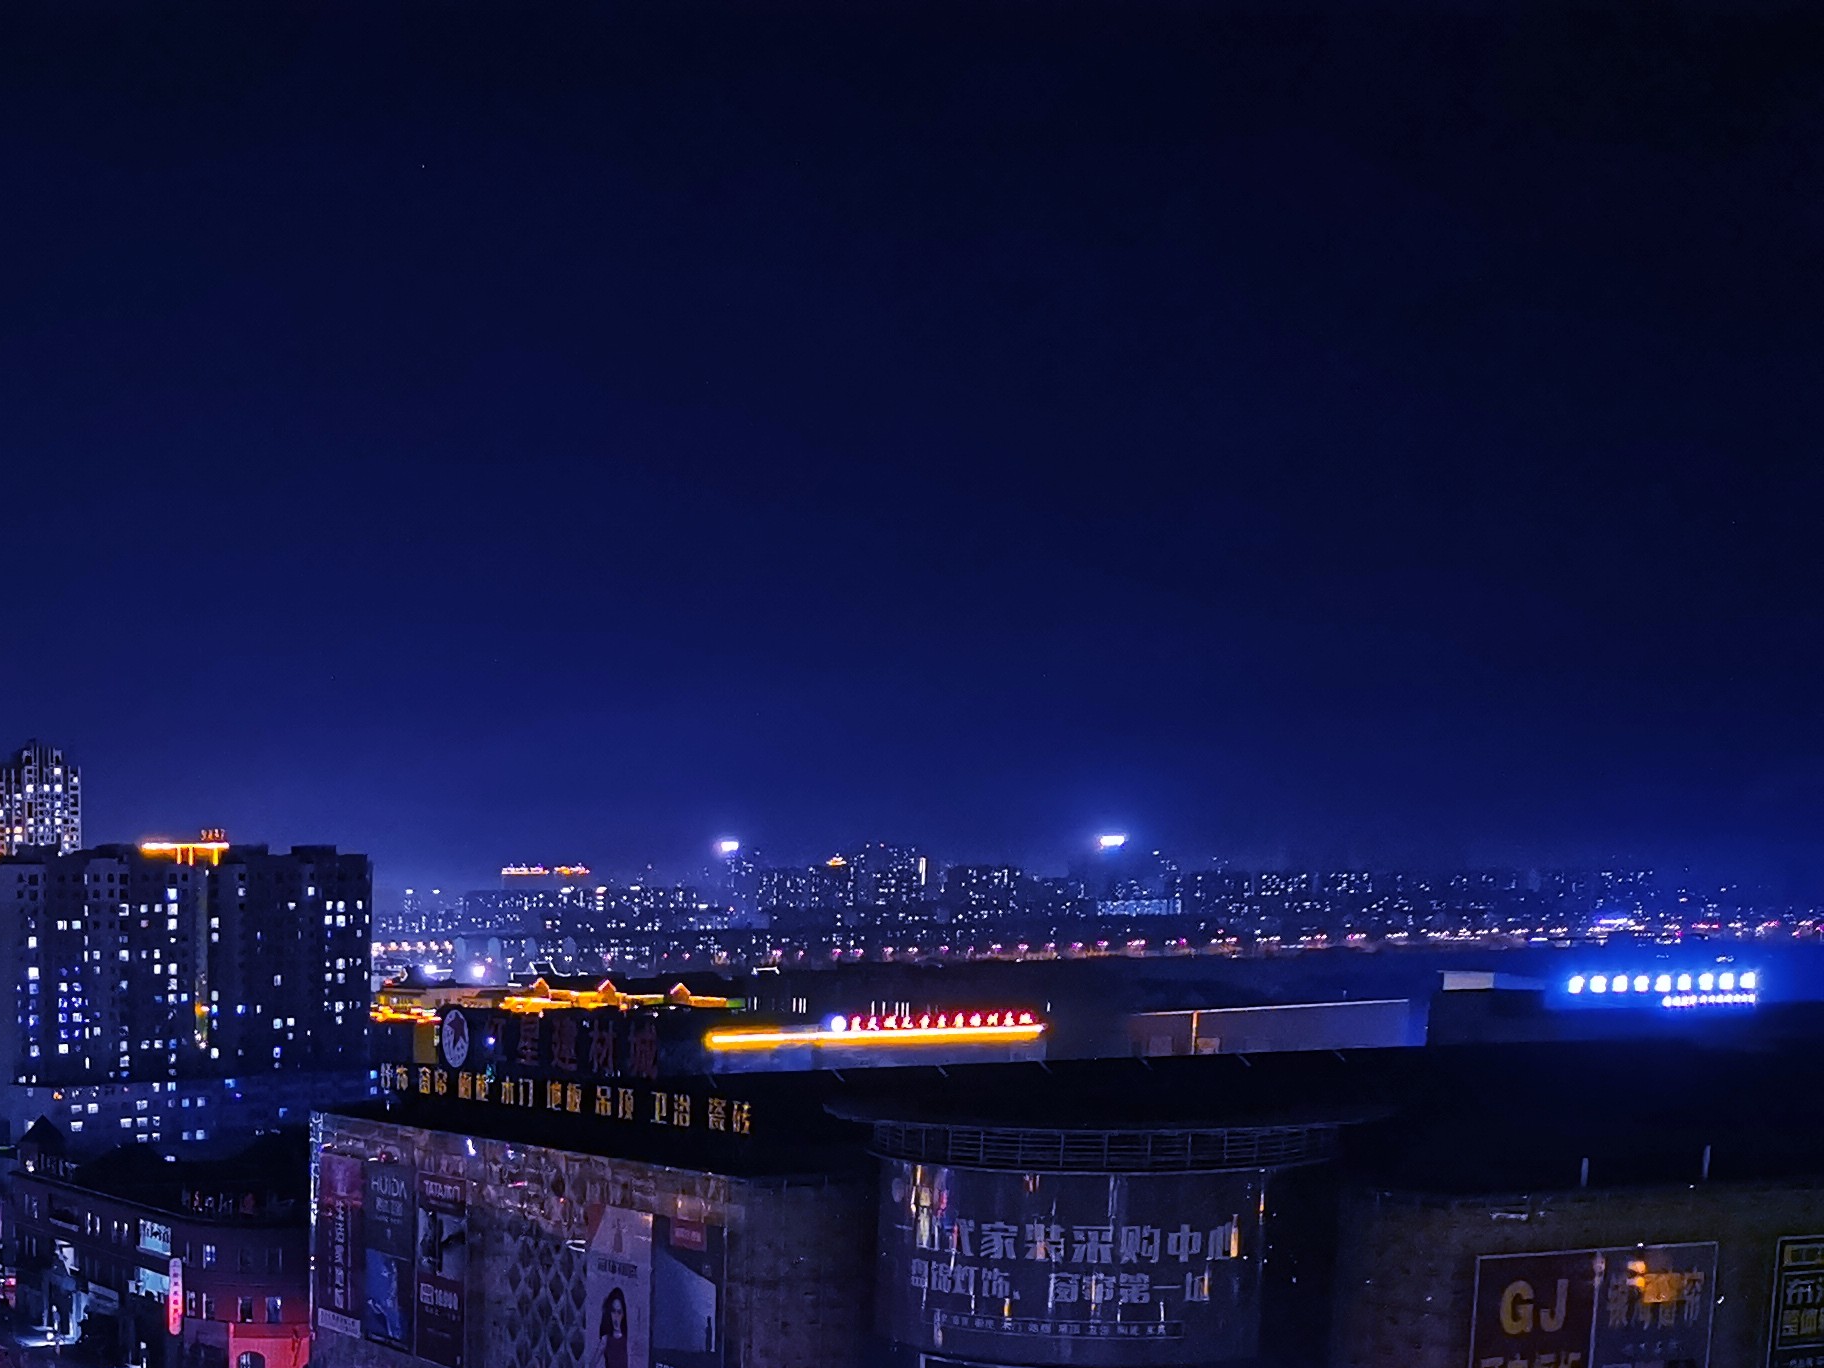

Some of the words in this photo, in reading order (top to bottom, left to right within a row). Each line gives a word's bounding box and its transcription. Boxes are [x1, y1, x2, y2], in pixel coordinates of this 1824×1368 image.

[418, 1066, 449, 1096] 窗帘
[500, 1077, 535, 1108] 木门
[545, 1080, 582, 1114] 地板
[594, 1085, 636, 1121] 吊顶
[650, 1091, 692, 1128] 卫浴
[707, 1096, 752, 1136] 瓷砖
[1499, 1277, 1569, 1335] GJ
